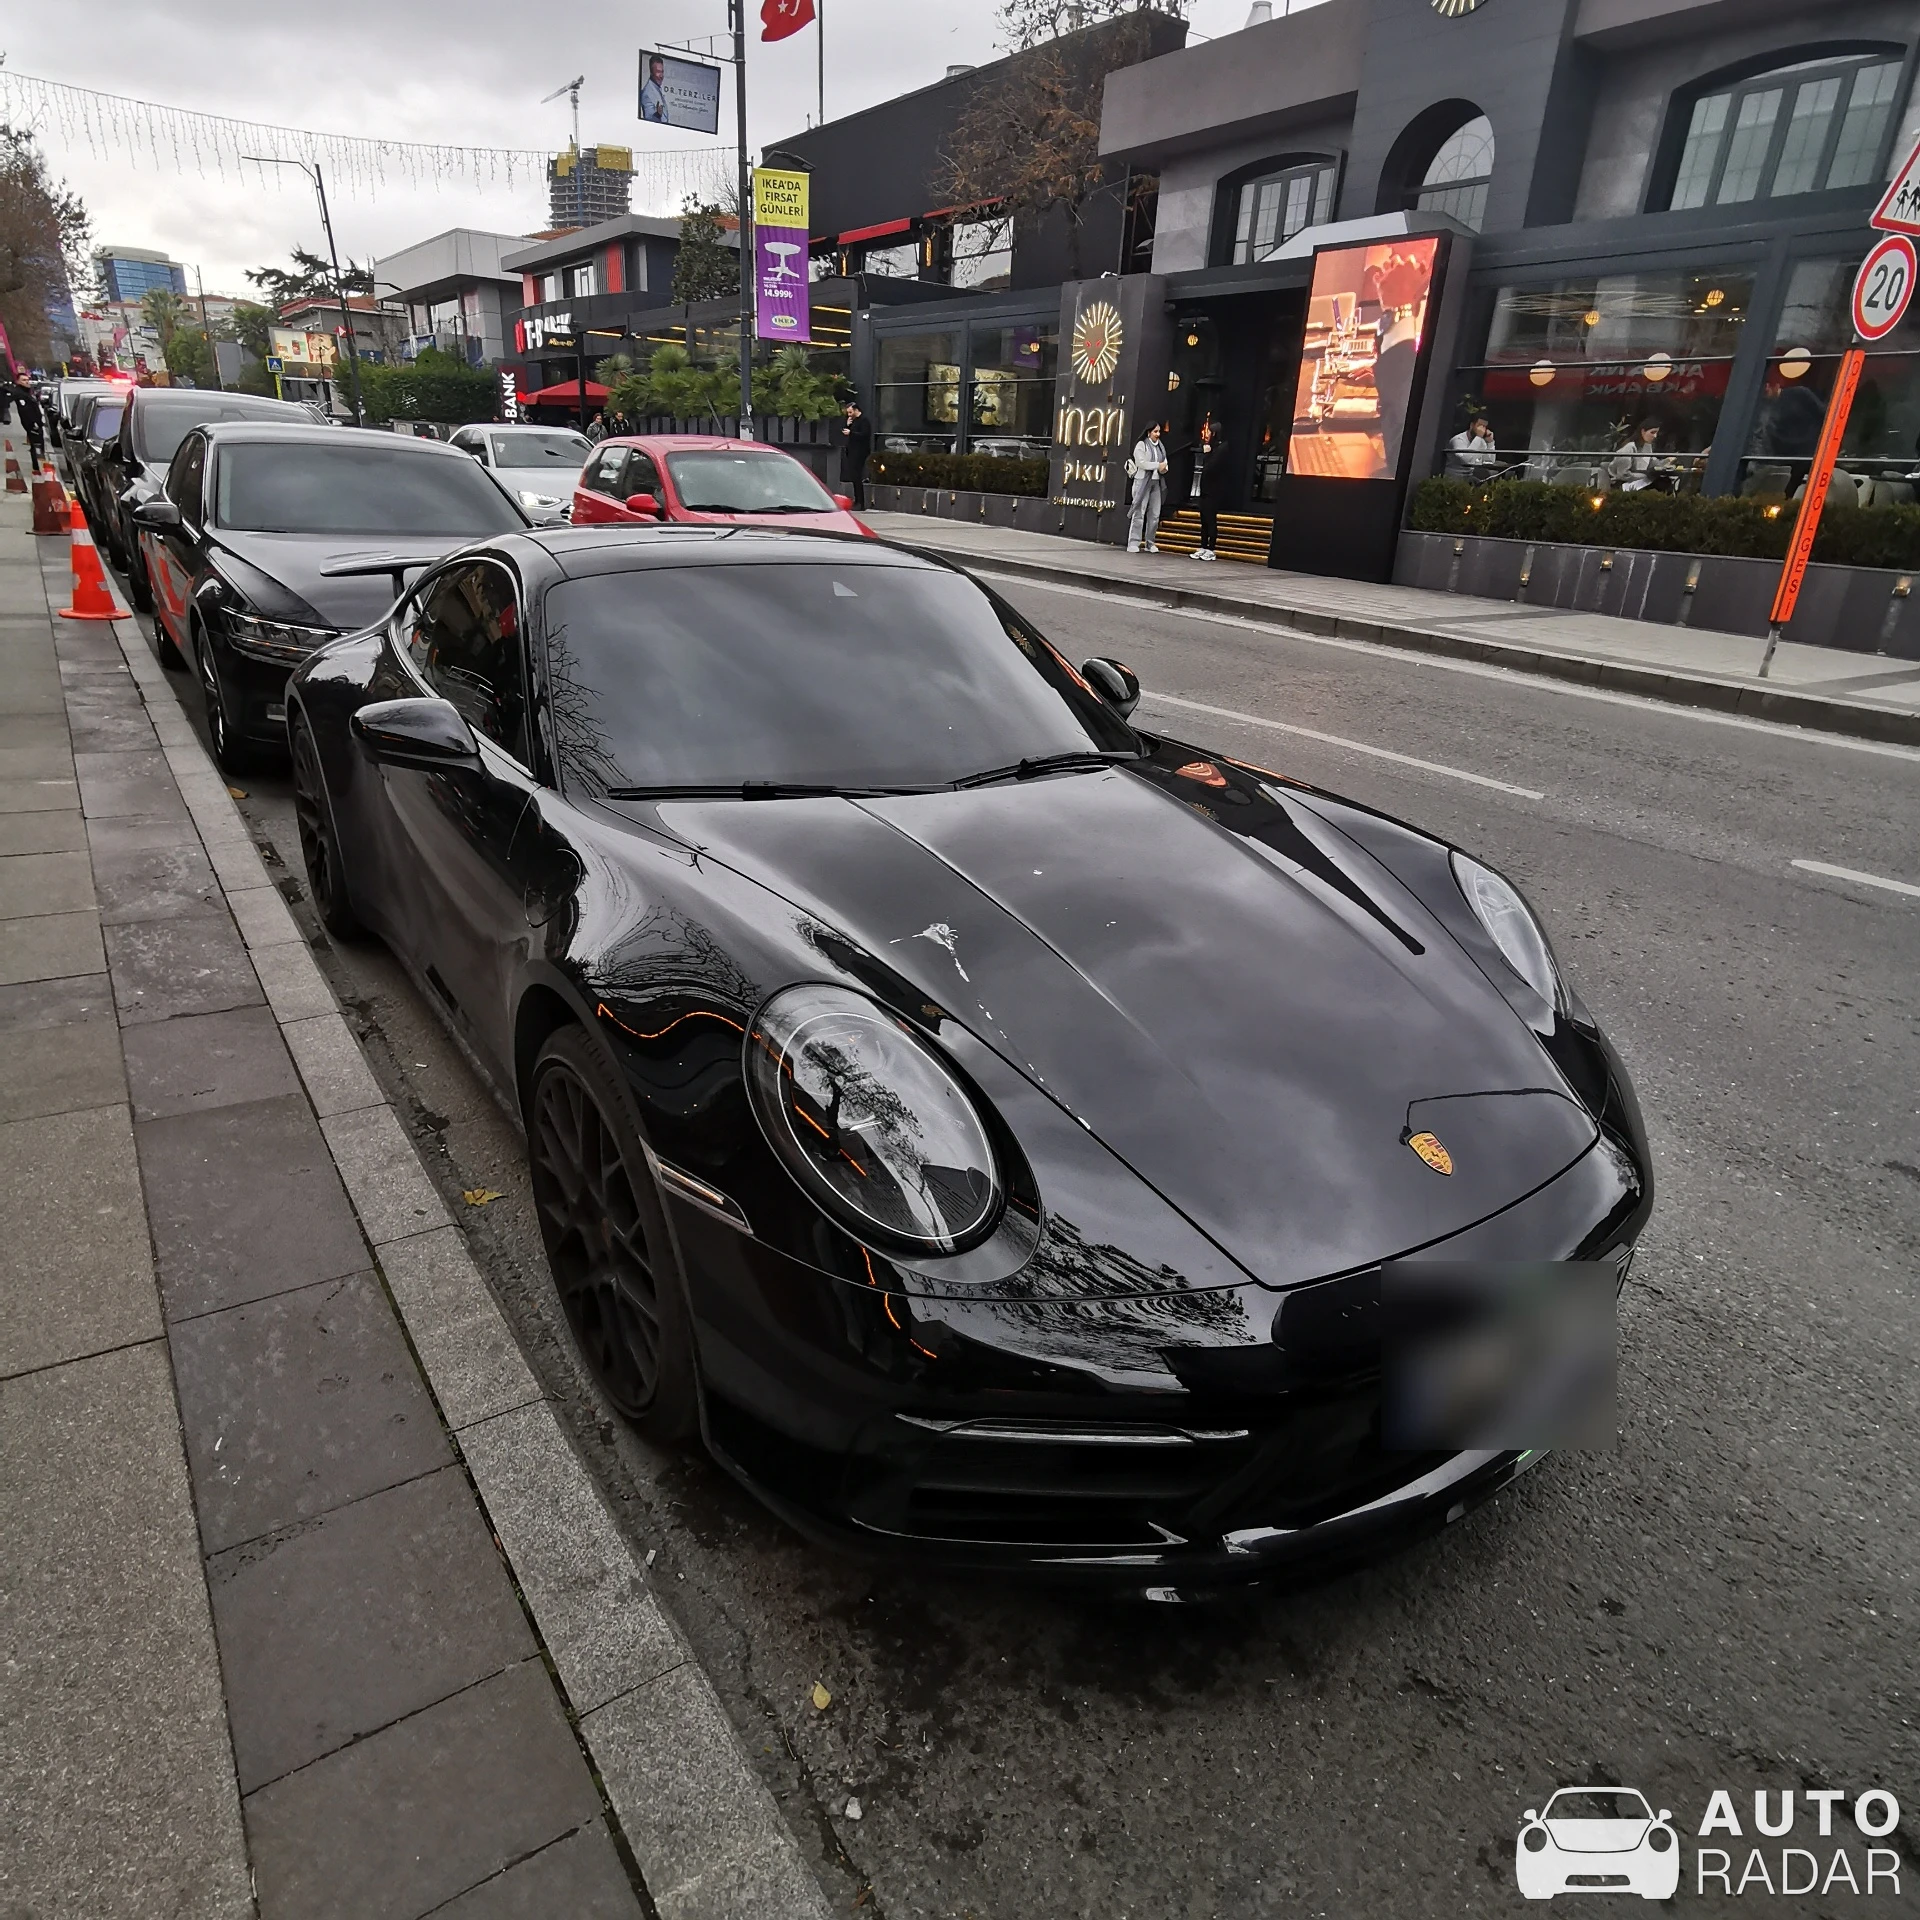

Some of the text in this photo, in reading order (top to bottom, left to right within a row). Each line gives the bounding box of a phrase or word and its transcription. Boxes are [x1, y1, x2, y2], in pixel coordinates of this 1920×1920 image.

[678, 88, 717, 102] TERZLER
[762, 178, 801, 191] IKEA'DA
[765, 191, 798, 203] FIRSAT
[760, 202, 803, 216] GÜNLERİ
[1864, 264, 1905, 311] 20
[774, 317, 795, 325] IKEA
[1832, 360, 1860, 441] OKUL
[1057, 395, 1124, 446] inari
